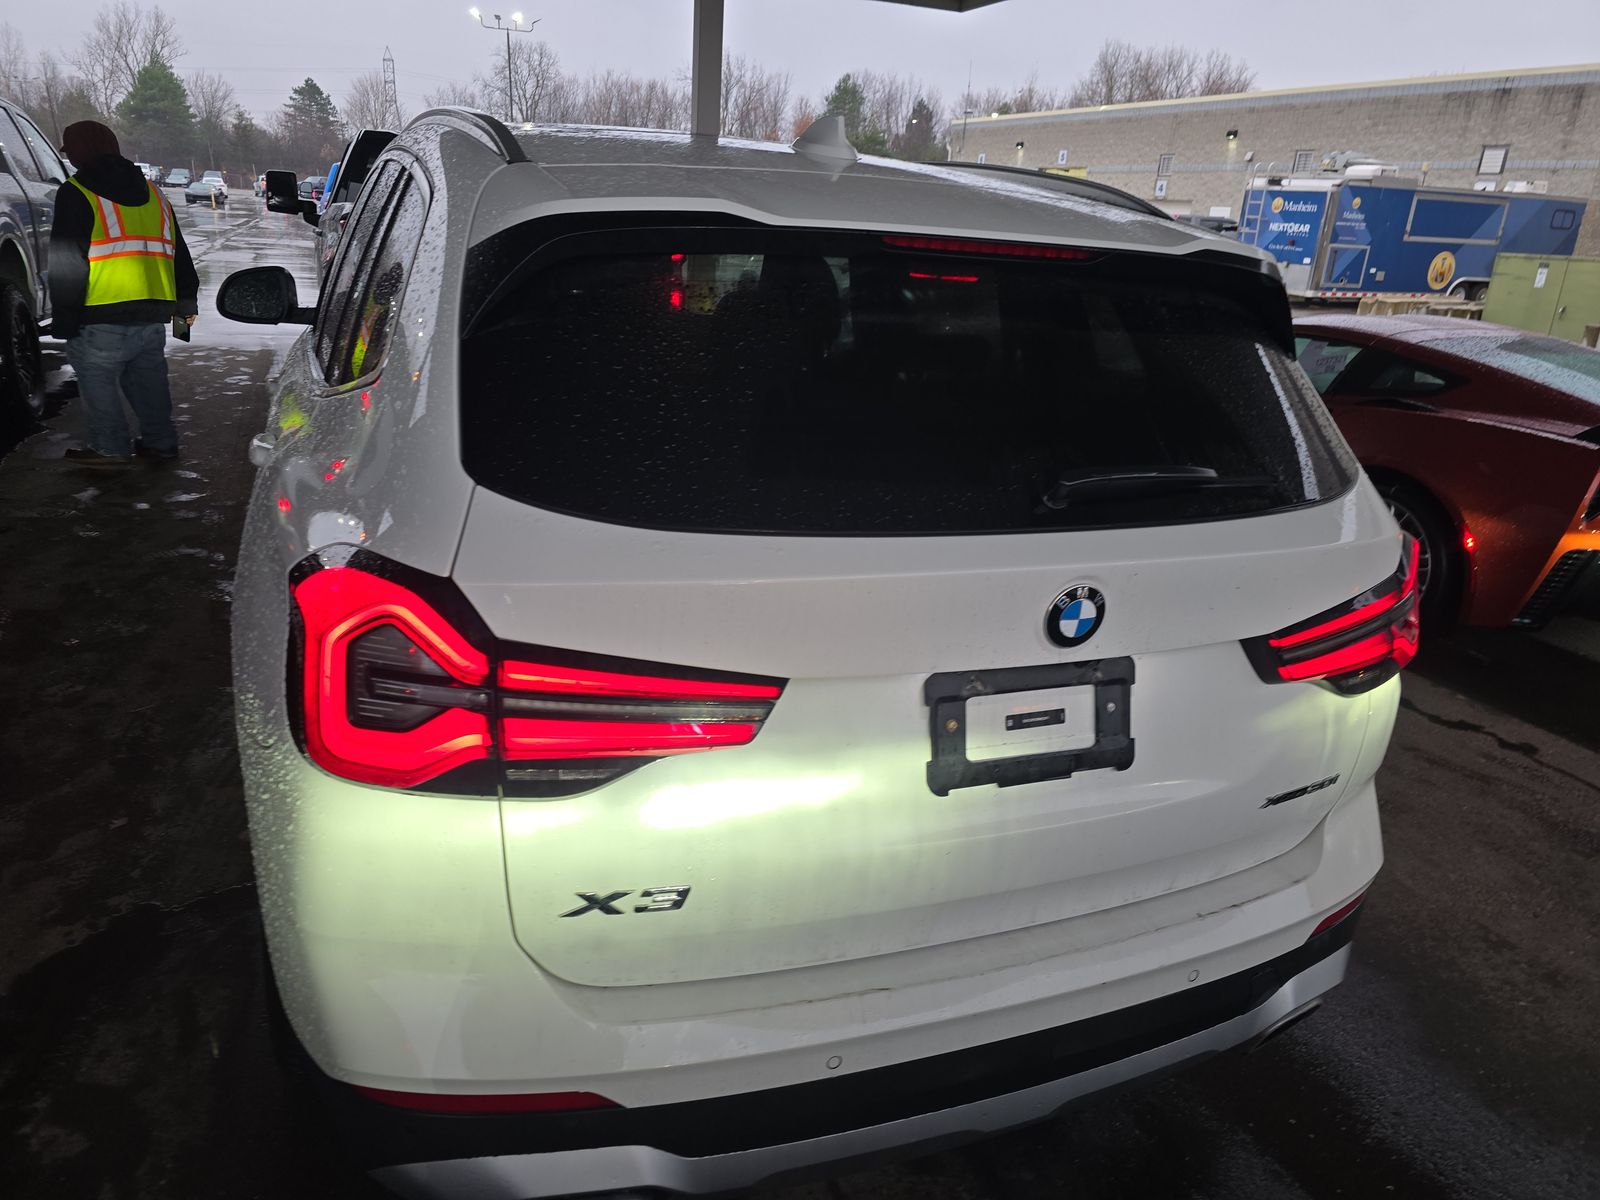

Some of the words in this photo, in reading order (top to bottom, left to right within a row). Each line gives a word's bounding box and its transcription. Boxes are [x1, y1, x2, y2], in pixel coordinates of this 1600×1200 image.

[1282, 201, 1317, 212] Manheim
[1269, 222, 1310, 232] NEXTGEAR
[1056, 586, 1105, 610] BMW
[558, 885, 692, 918] X3
